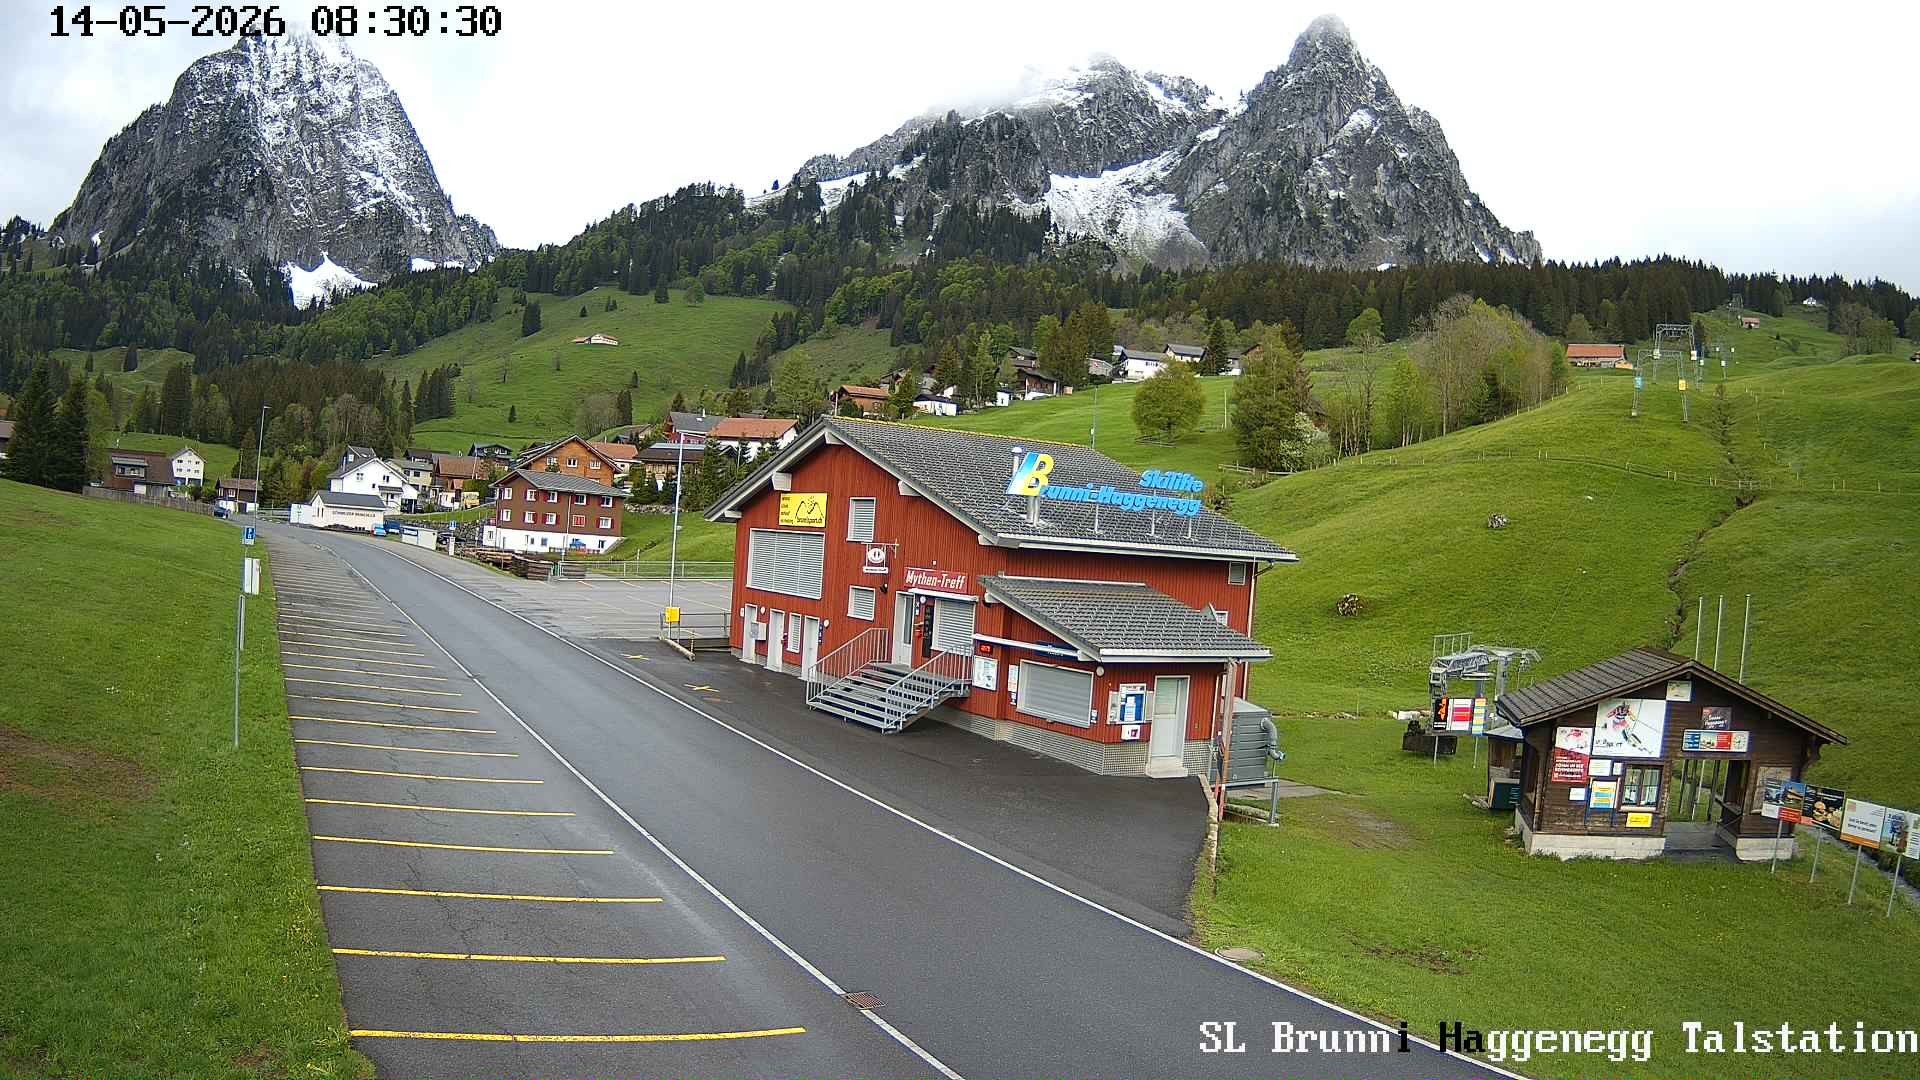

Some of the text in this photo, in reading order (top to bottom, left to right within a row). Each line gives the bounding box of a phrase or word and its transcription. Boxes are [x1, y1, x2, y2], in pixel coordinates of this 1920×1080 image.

[1016, 453, 1202, 517] Brunni-Haggenegg
[1139, 469, 1205, 493] Skilifte
[905, 570, 966, 590] Mythen-Treff
